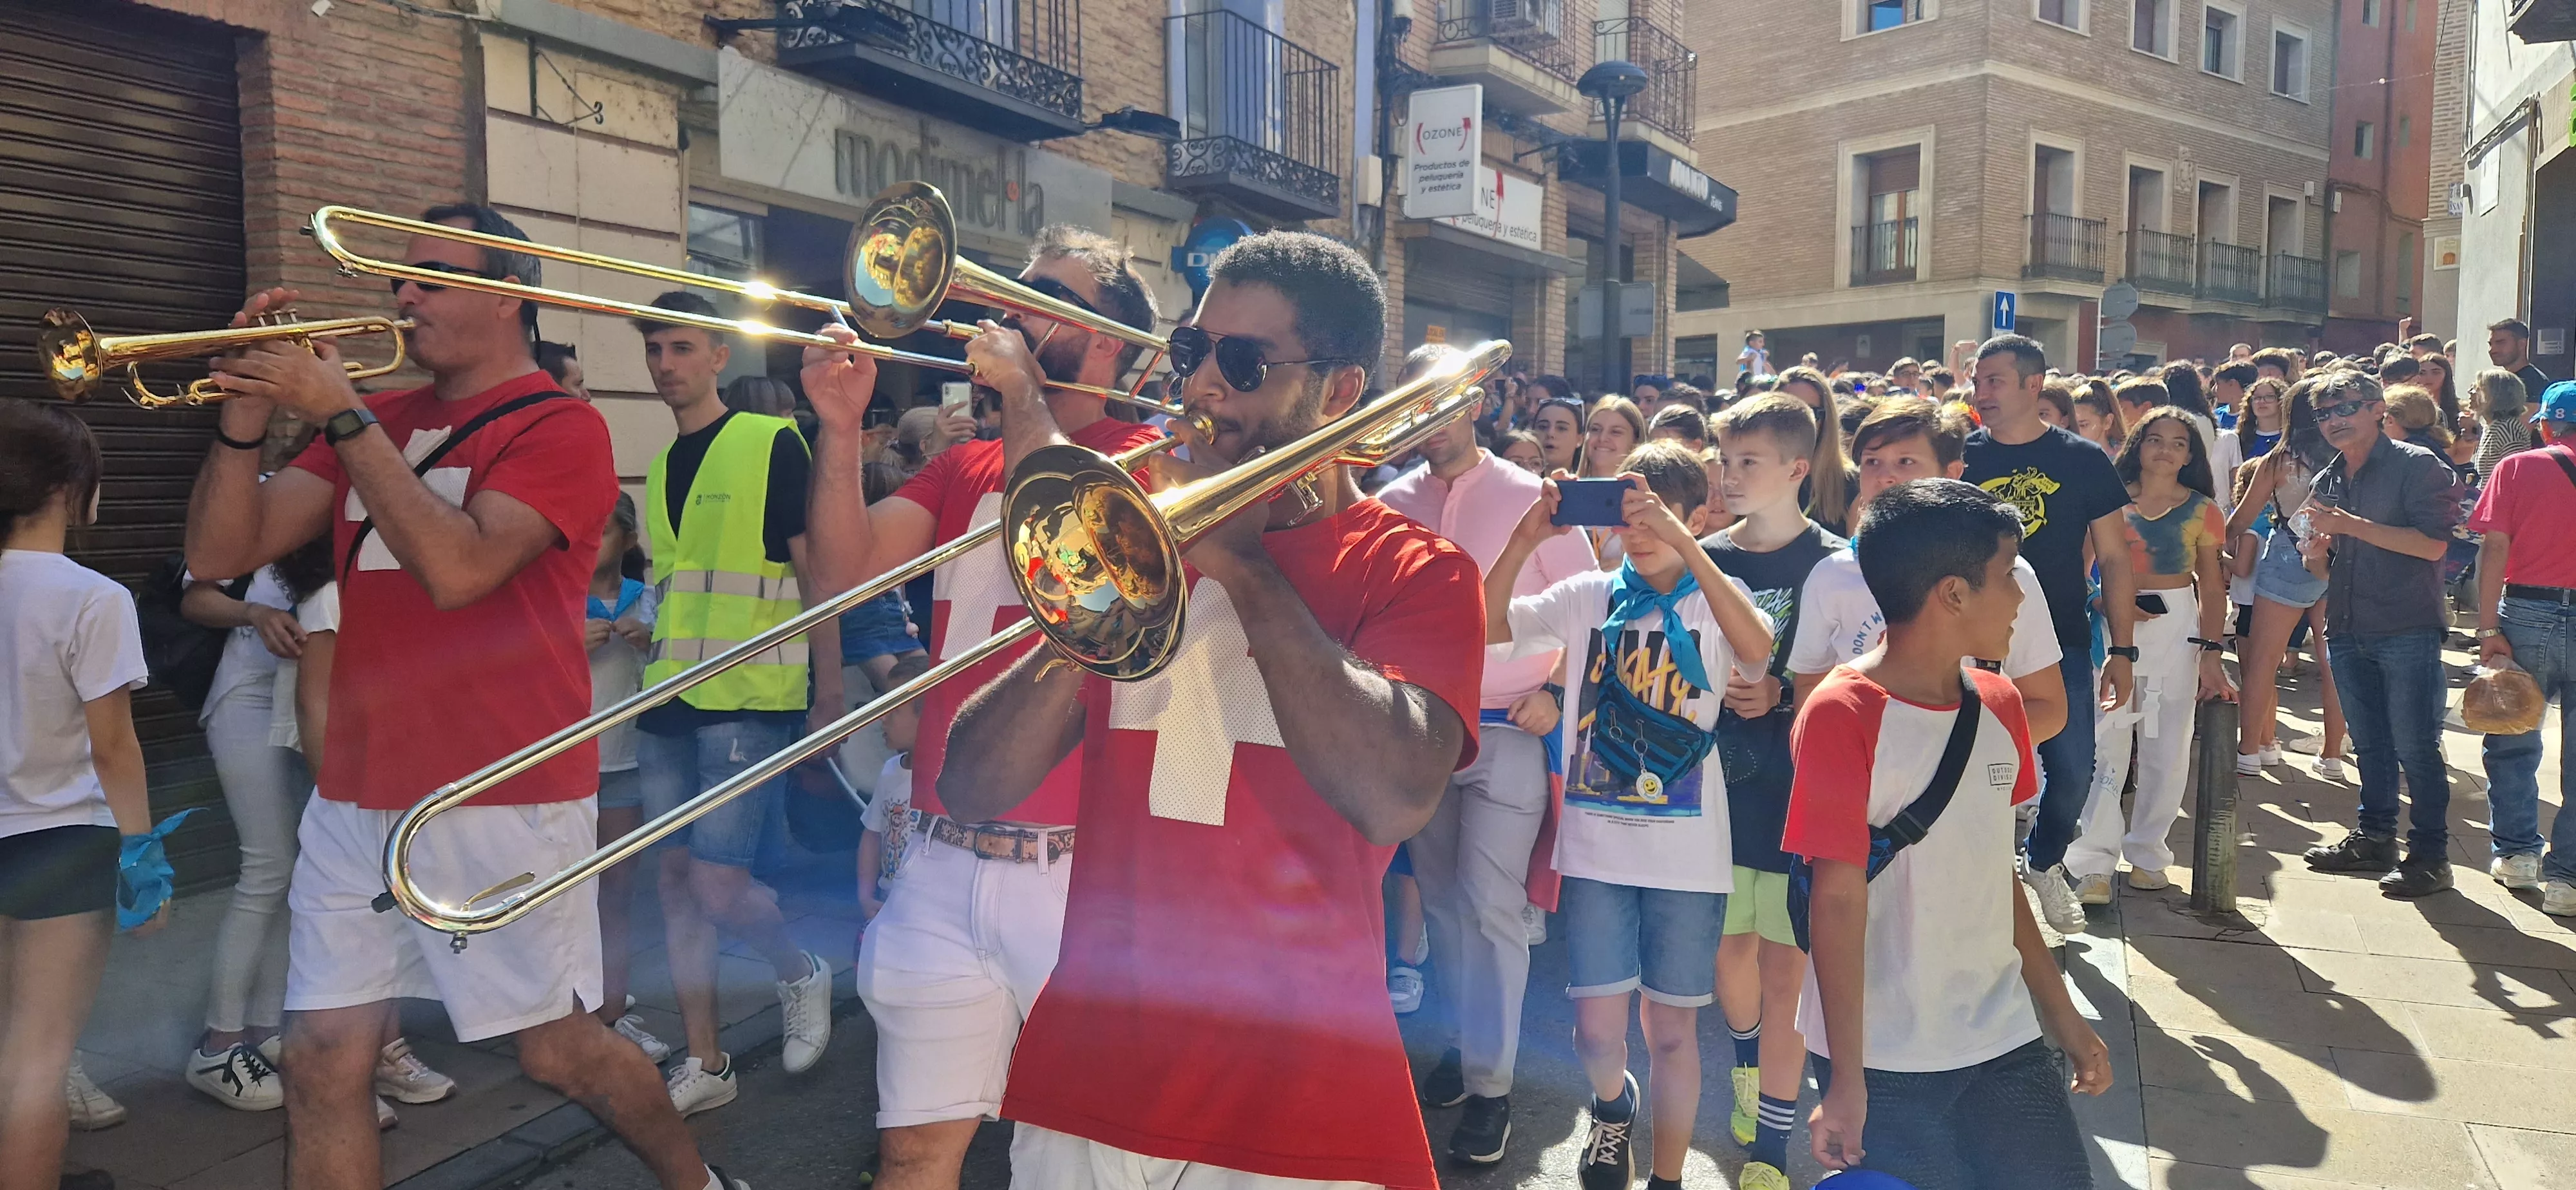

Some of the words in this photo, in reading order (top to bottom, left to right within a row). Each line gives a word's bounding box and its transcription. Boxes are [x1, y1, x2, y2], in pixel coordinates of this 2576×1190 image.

[1423, 127, 1463, 140] OZONE
[1414, 162, 1457, 171] Productos
[1428, 184, 1462, 193] estética
[1503, 224, 1508, 238] y
[1510, 225, 1537, 242] estética
[1187, 252, 1217, 267] DI
[2555, 408, 2565, 419] 8
[1870, 611, 1882, 625] W
